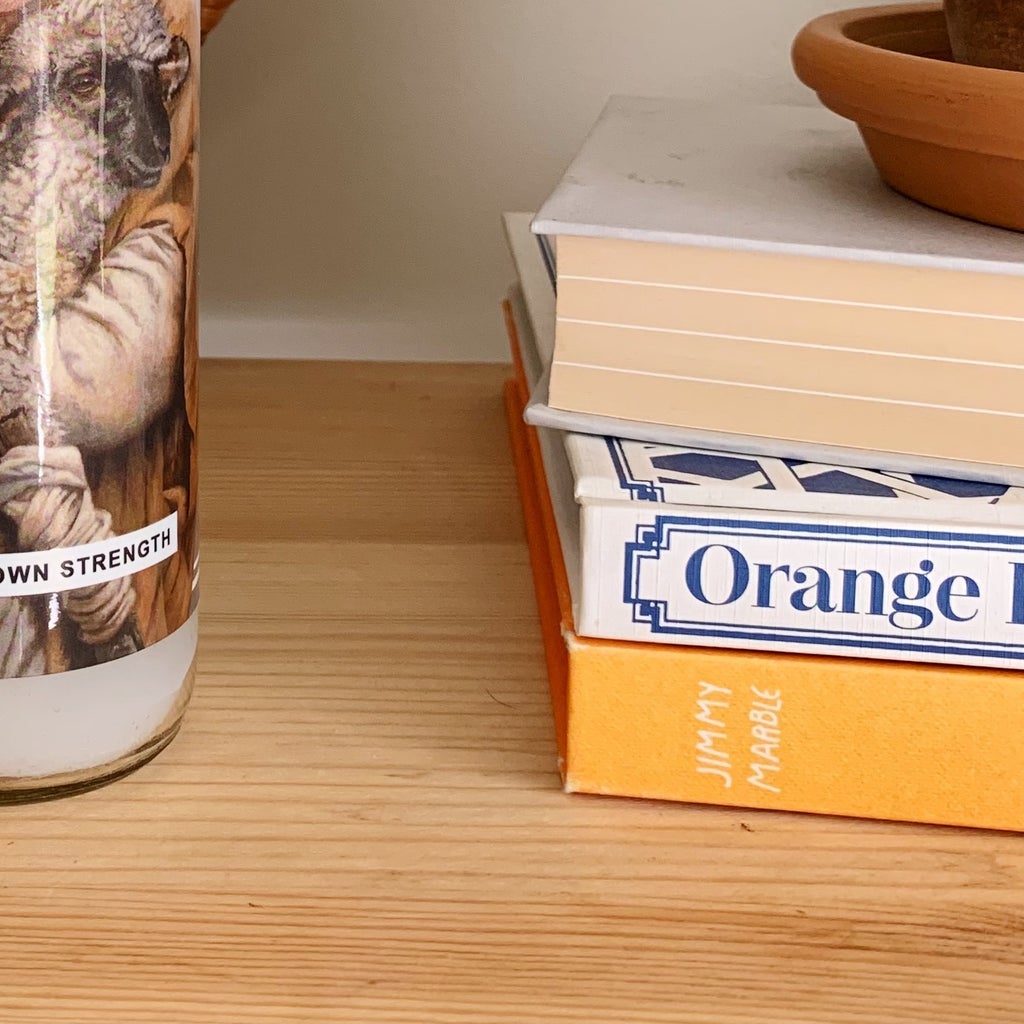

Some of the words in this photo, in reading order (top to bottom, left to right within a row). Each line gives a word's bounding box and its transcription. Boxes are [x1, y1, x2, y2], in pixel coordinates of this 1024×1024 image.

[60, 528, 171, 579] STRENGTH
[685, 543, 981, 630] Orange
[694, 681, 733, 789] JIMMY
[746, 684, 783, 794] MARBLE
